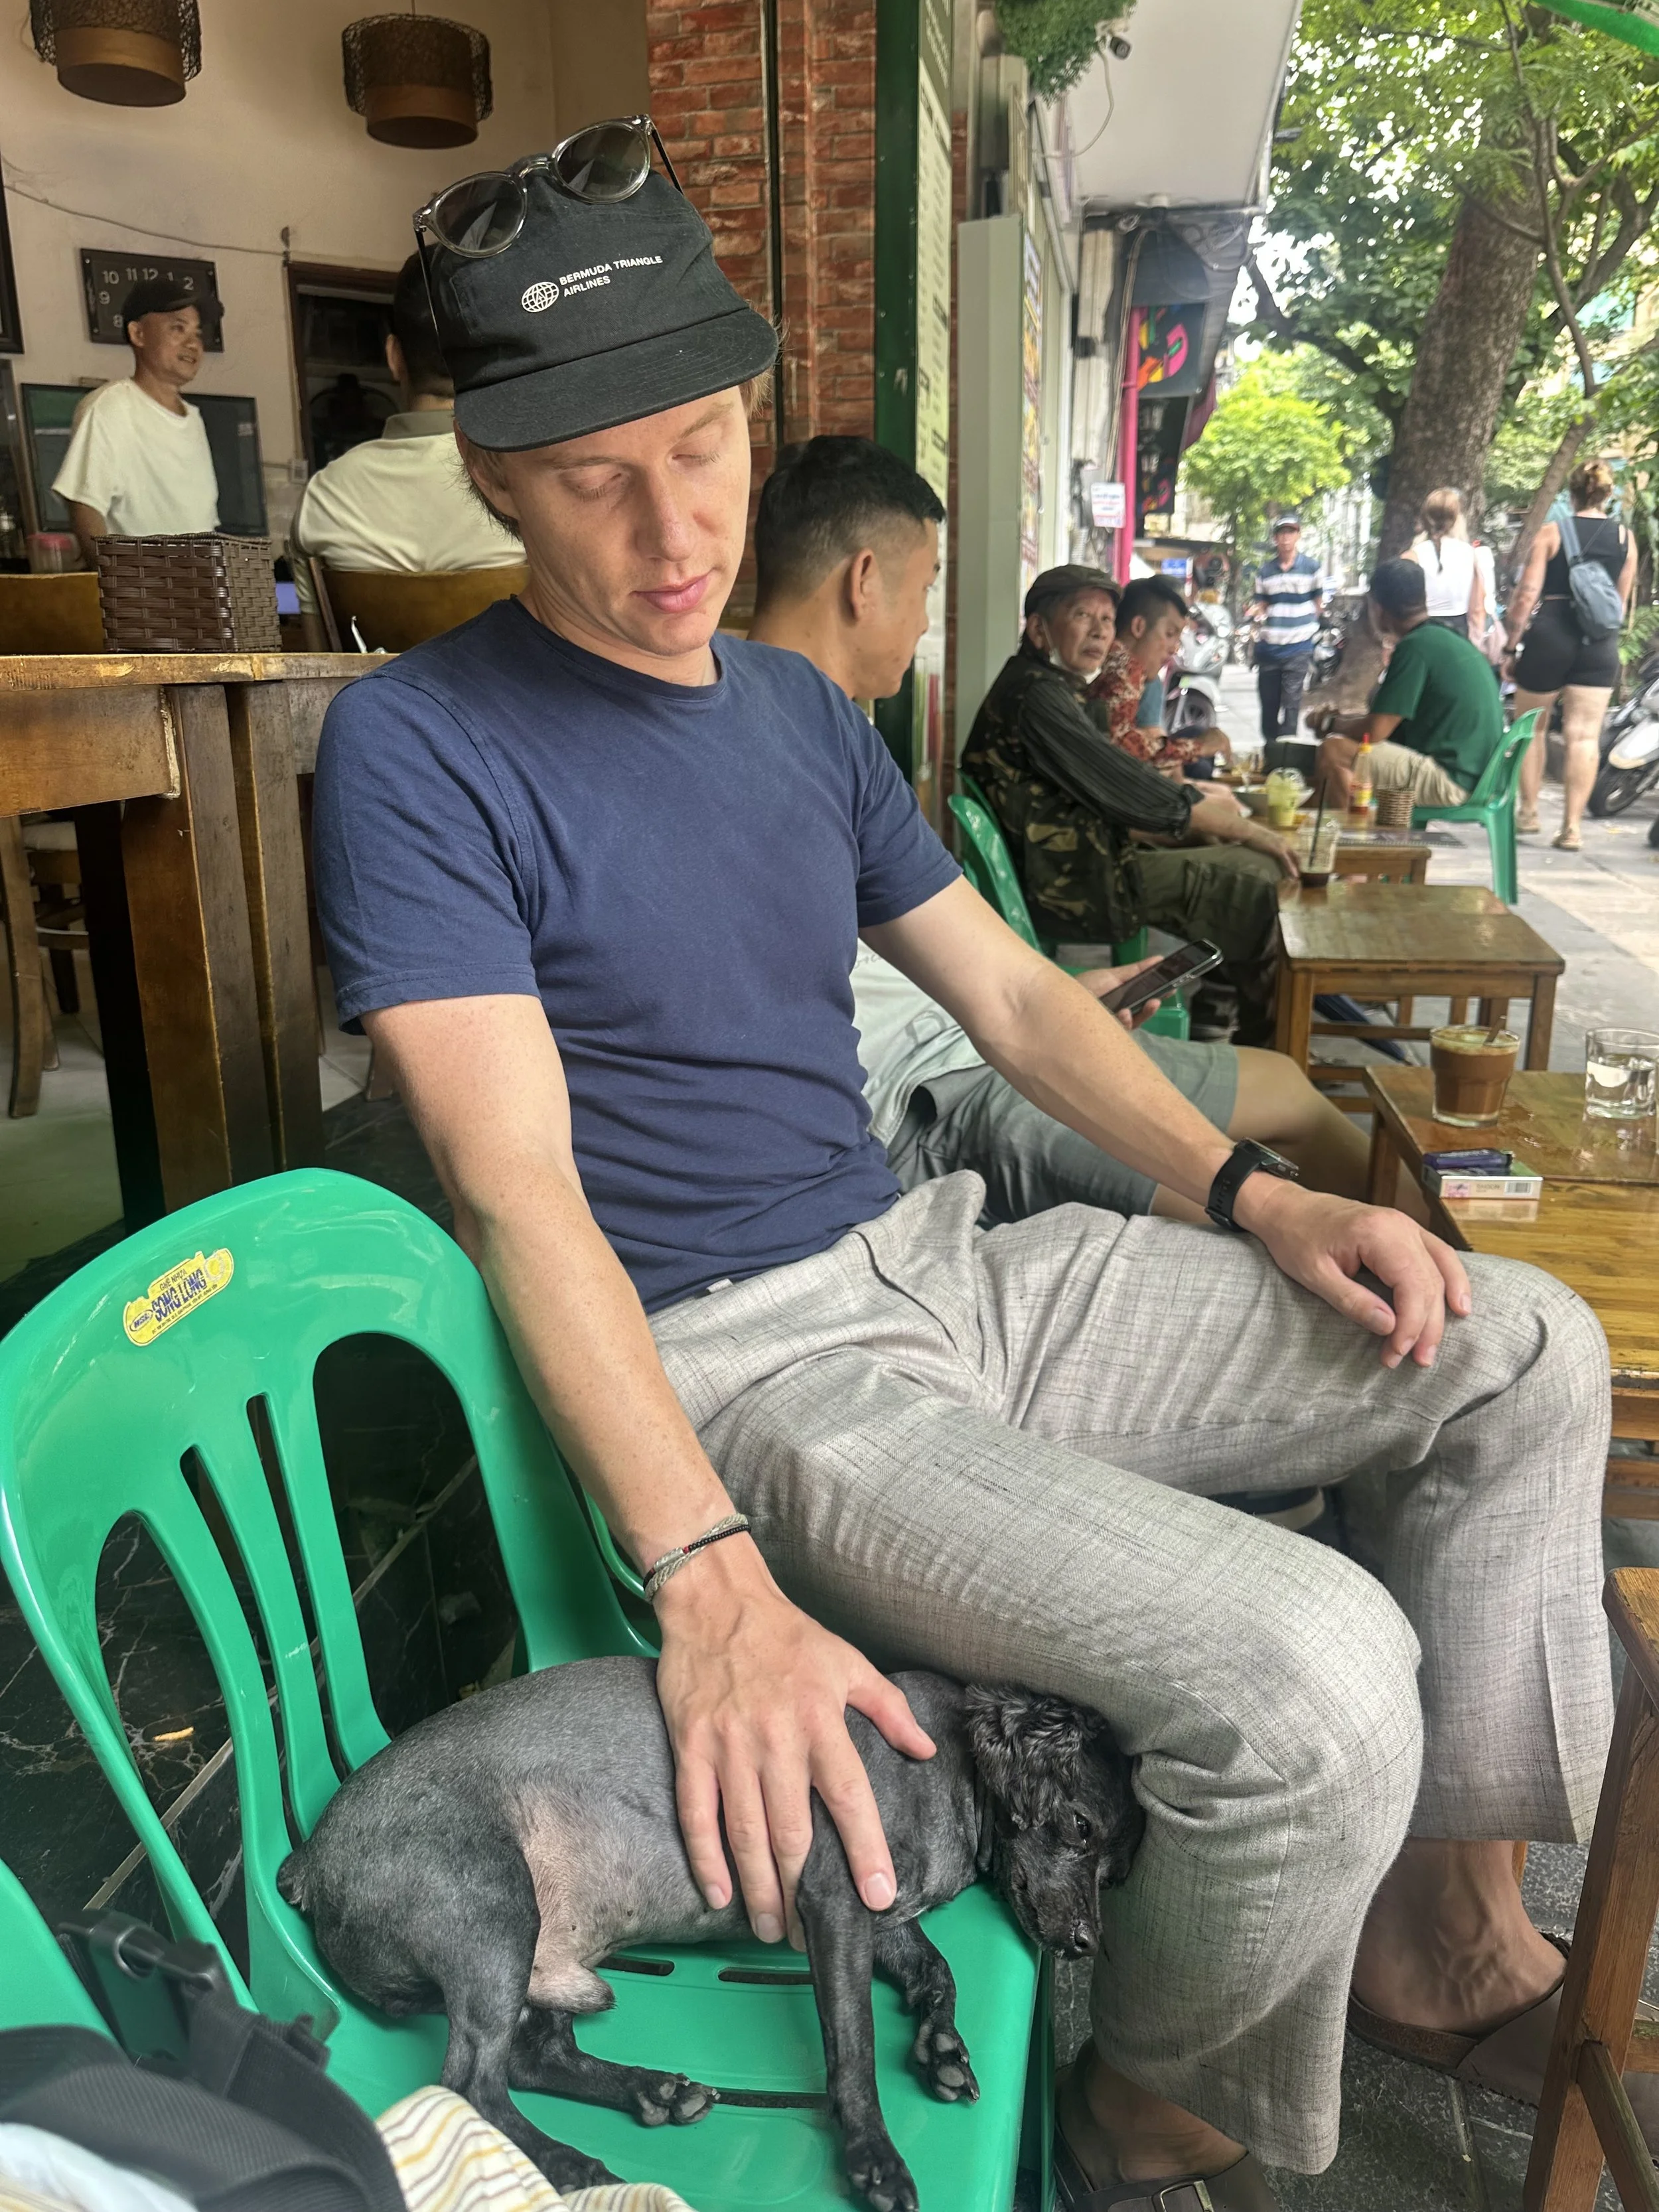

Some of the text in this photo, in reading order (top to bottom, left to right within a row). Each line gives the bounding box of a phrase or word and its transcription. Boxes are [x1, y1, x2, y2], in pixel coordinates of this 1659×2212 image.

[102, 270, 119, 284] 10
[126, 267, 138, 282] 11
[183, 276, 194, 291] 2
[559, 256, 663, 285] BERMUDA TRIANGLE
[564, 275, 611, 297] AIRLINES
[100, 291, 110, 305] 9
[113, 315, 123, 328] 8
[151, 1286, 182, 1322] SONG
[178, 1268, 208, 1303] LONG
